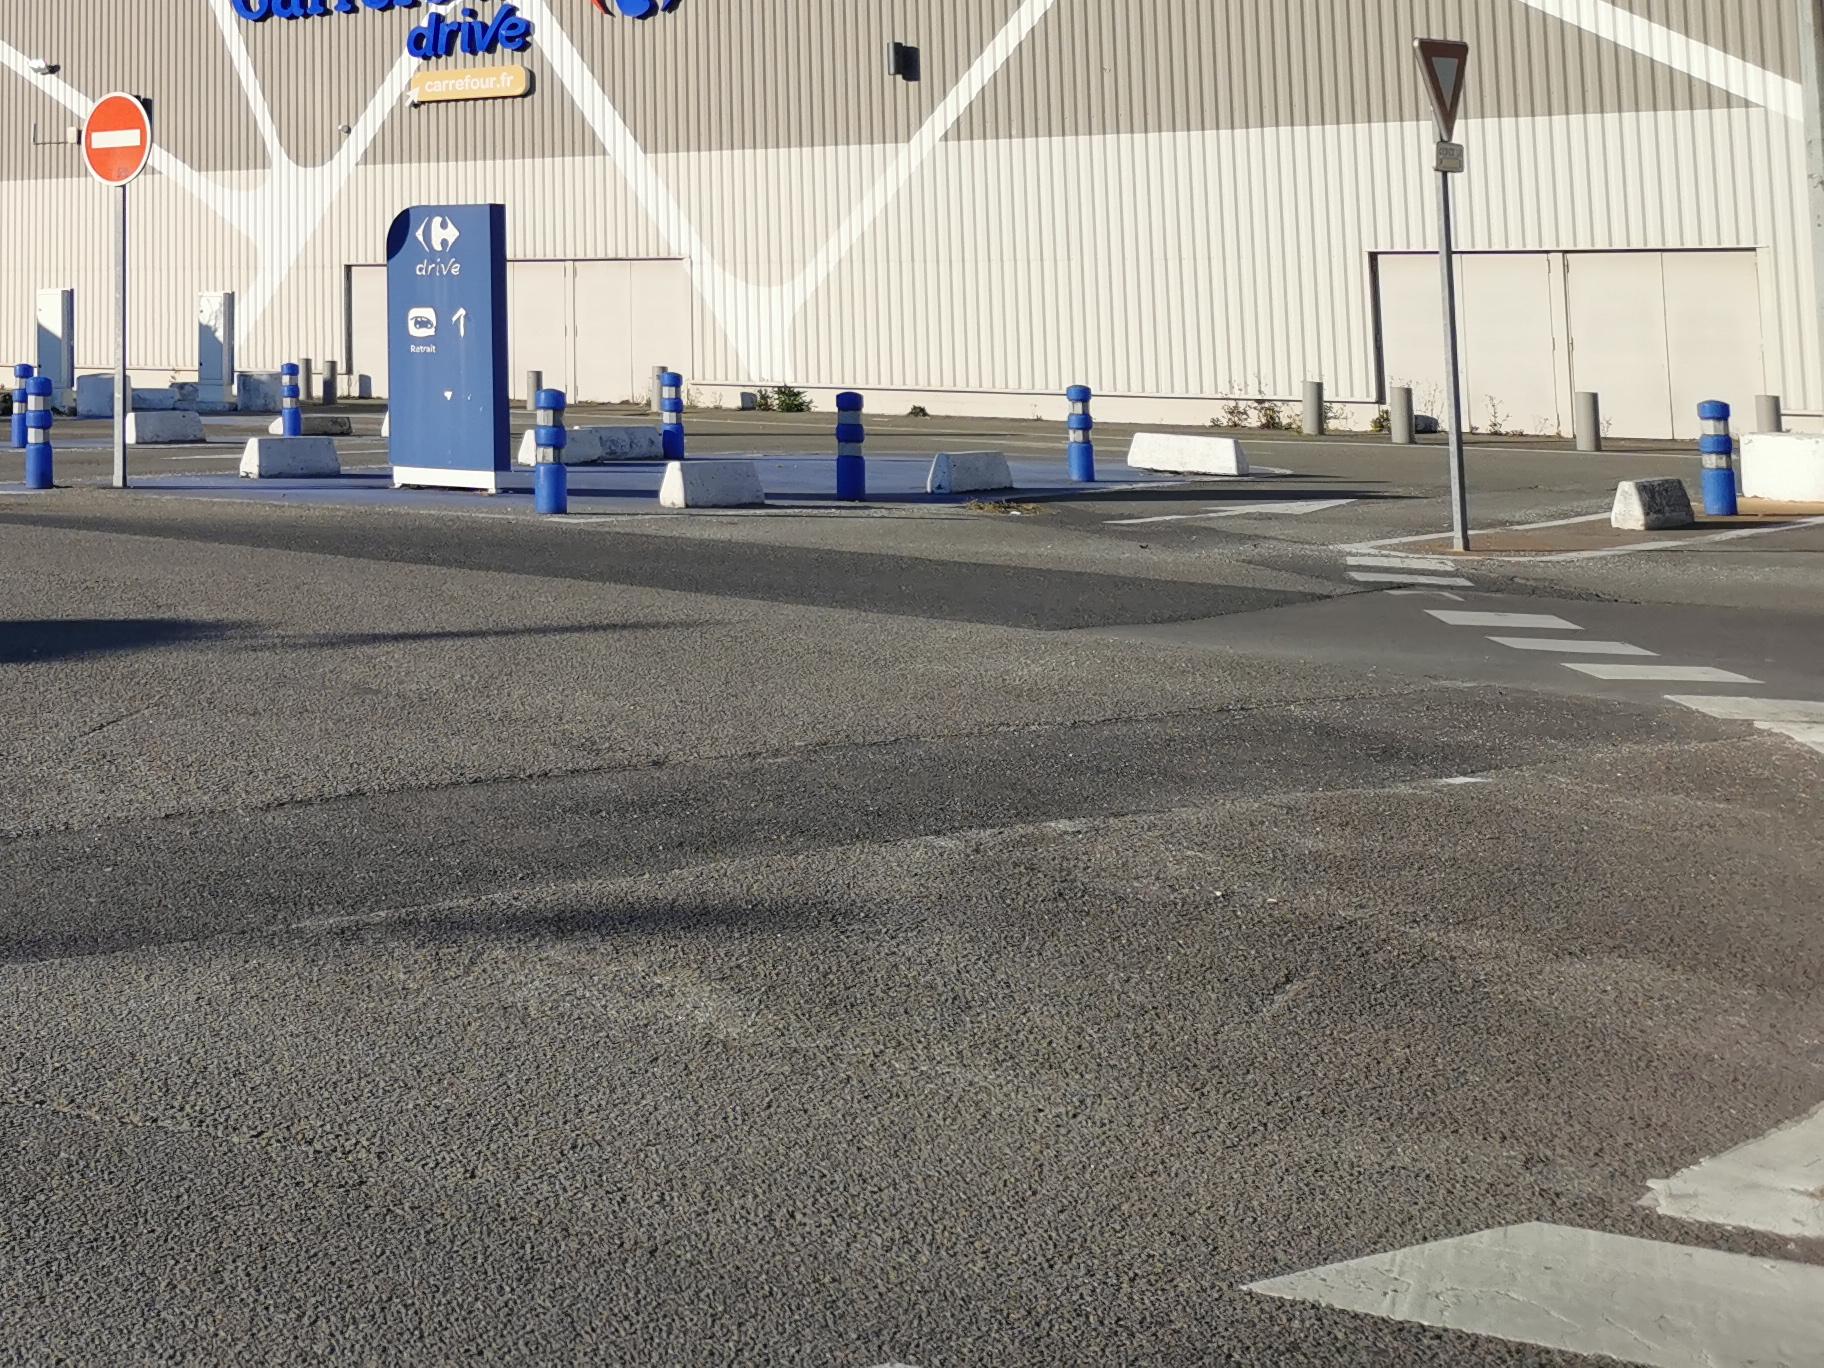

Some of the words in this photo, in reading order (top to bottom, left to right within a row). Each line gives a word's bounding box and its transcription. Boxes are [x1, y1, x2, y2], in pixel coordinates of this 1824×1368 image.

[407, 5, 533, 59] drive
[424, 72, 515, 93] carrefour.fr
[416, 258, 461, 276] drive
[410, 344, 436, 353] Retrait
